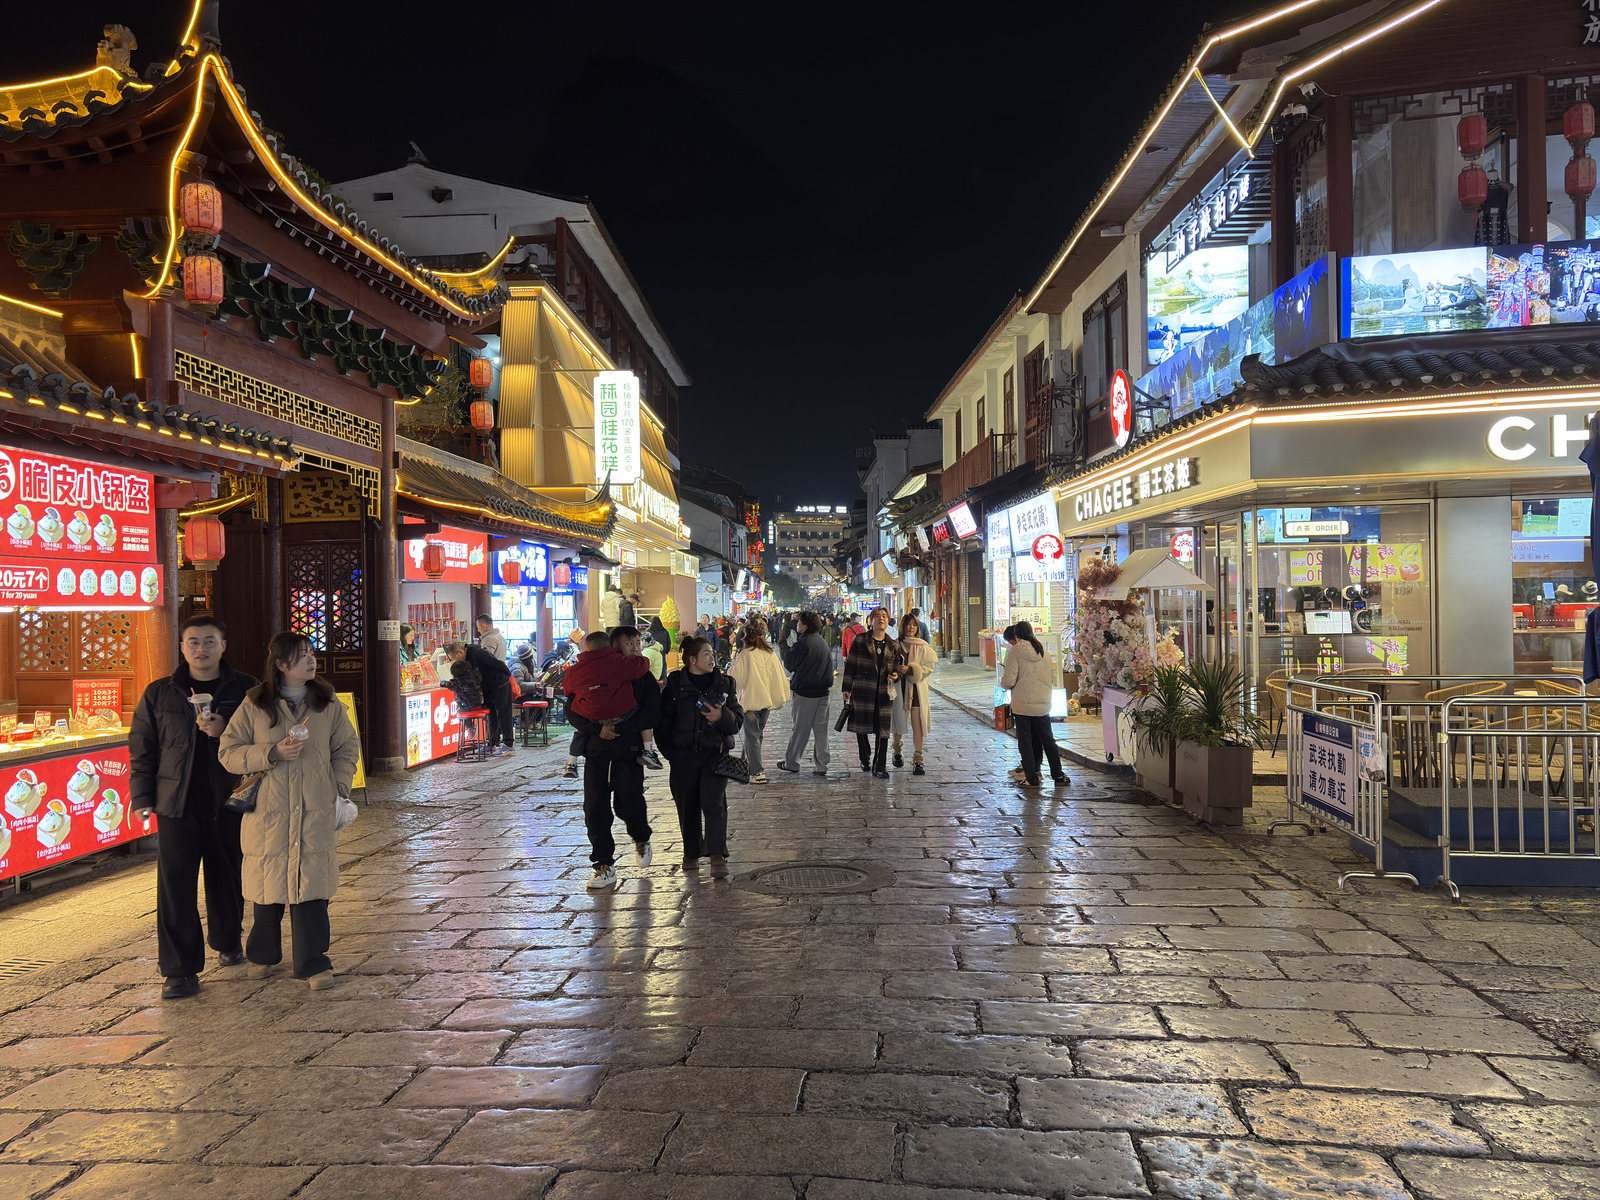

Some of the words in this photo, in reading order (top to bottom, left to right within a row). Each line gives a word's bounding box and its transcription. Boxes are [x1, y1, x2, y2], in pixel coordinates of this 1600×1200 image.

[20, 458, 149, 514] 脆皮小锅盔
[1075, 475, 1133, 521] CHAGEE
[1139, 457, 1191, 498] 霸王茶姬
[5, 591, 14, 599] for
[15, 592, 23, 600] 20
[23, 593, 37, 601] yuan
[1309, 743, 1347, 776] 武装执勤
[1309, 769, 1347, 805] 请勿靠近
